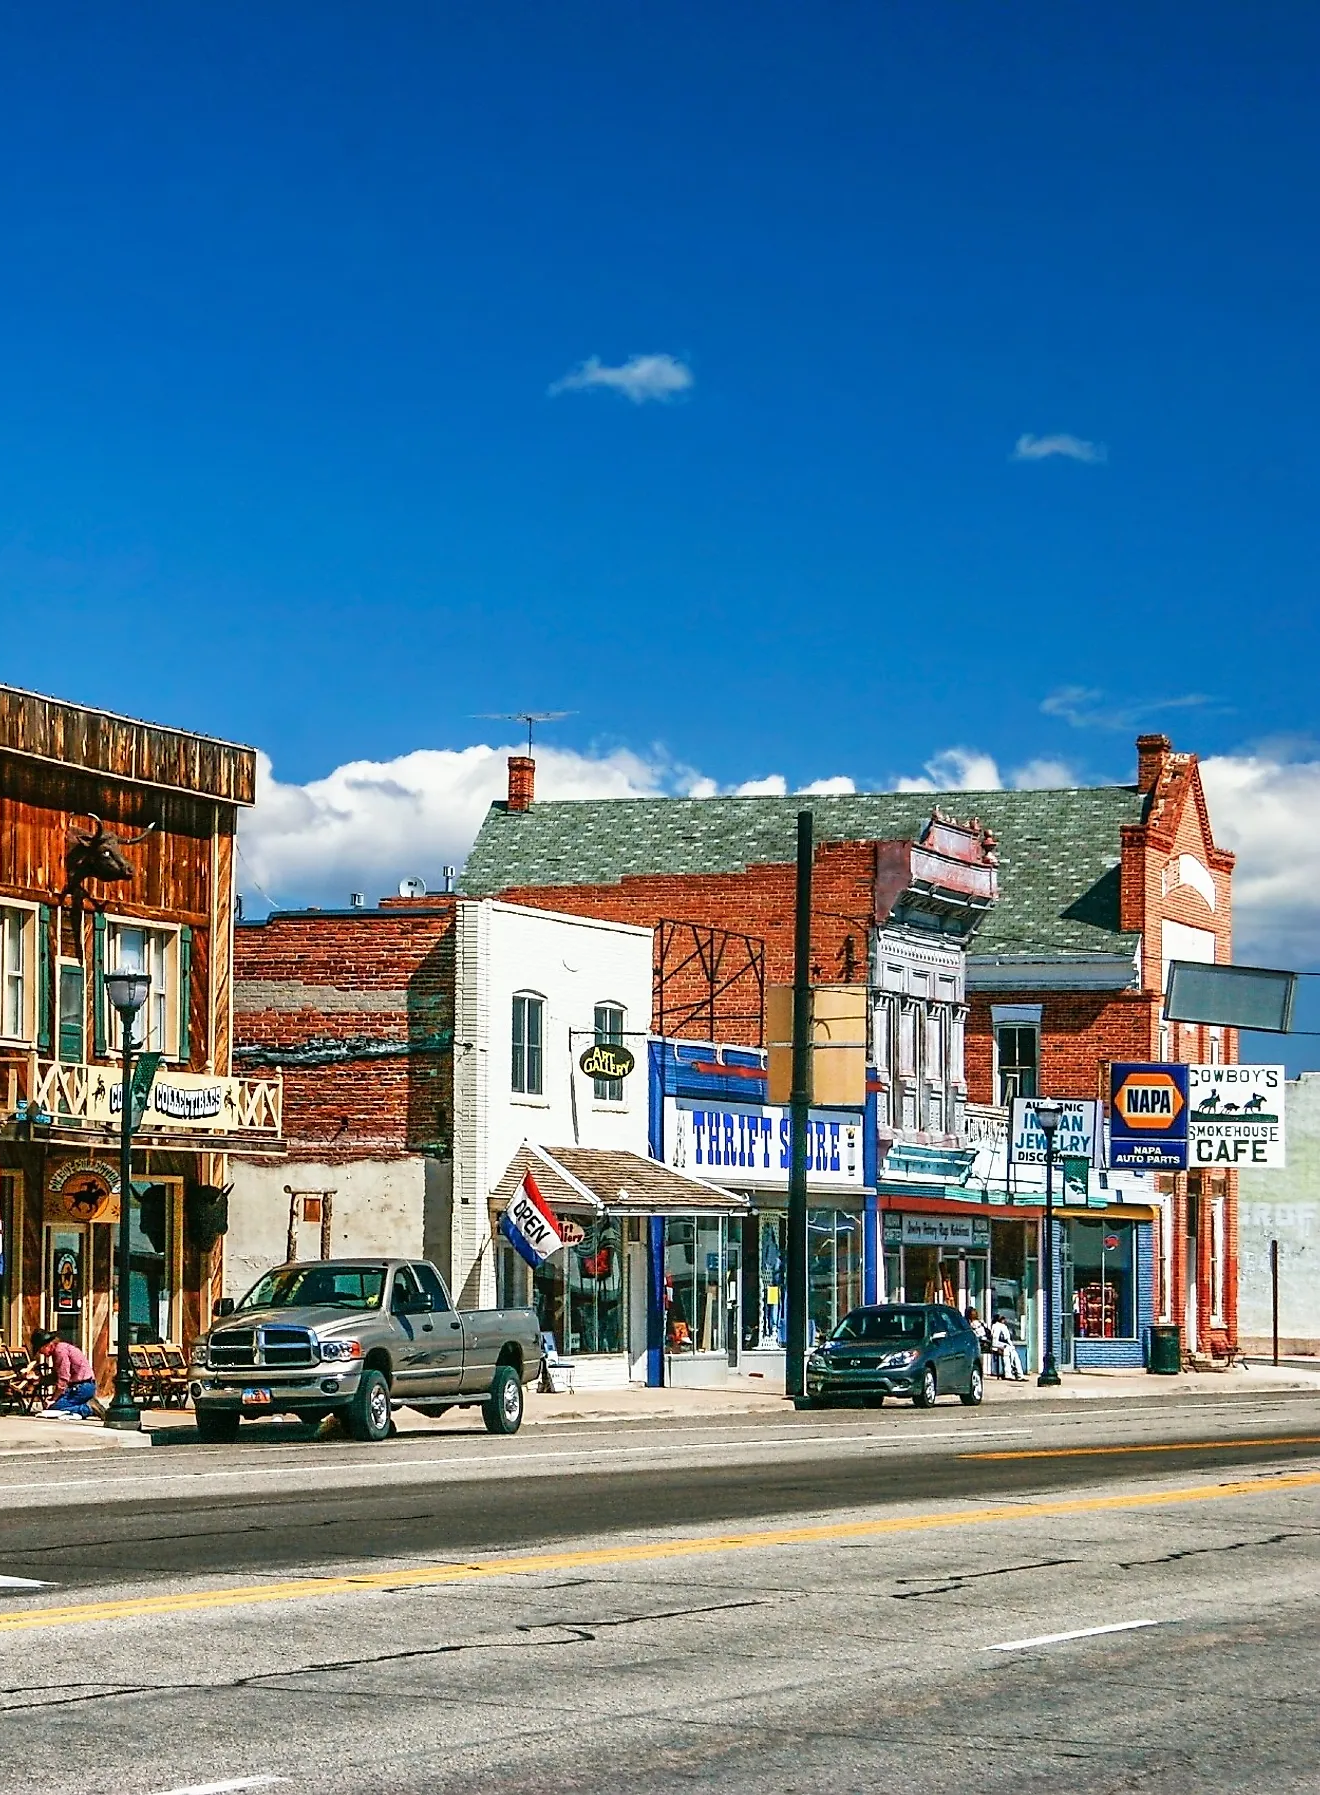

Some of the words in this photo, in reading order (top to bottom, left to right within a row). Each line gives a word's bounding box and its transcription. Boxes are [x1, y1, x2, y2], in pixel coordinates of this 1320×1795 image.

[592, 1046, 616, 1062] ART
[584, 1058, 630, 1077] GALLERY
[1190, 1069, 1278, 1088] COWBOY'S
[154, 1082, 222, 1120] COLLECTIBLES
[1126, 1088, 1171, 1114] NAPA
[1023, 1112, 1083, 1131] INAN
[692, 1110, 772, 1168] THRIFT
[780, 1117, 841, 1171] SORE
[1188, 1125, 1280, 1142] SMOKEHOUSE
[1116, 1153, 1144, 1163] AUTO
[1146, 1155, 1180, 1164] PARTS
[1133, 1146, 1162, 1155] NAPA
[1196, 1139, 1268, 1162] CAFE
[513, 1199, 550, 1244] OPEN
